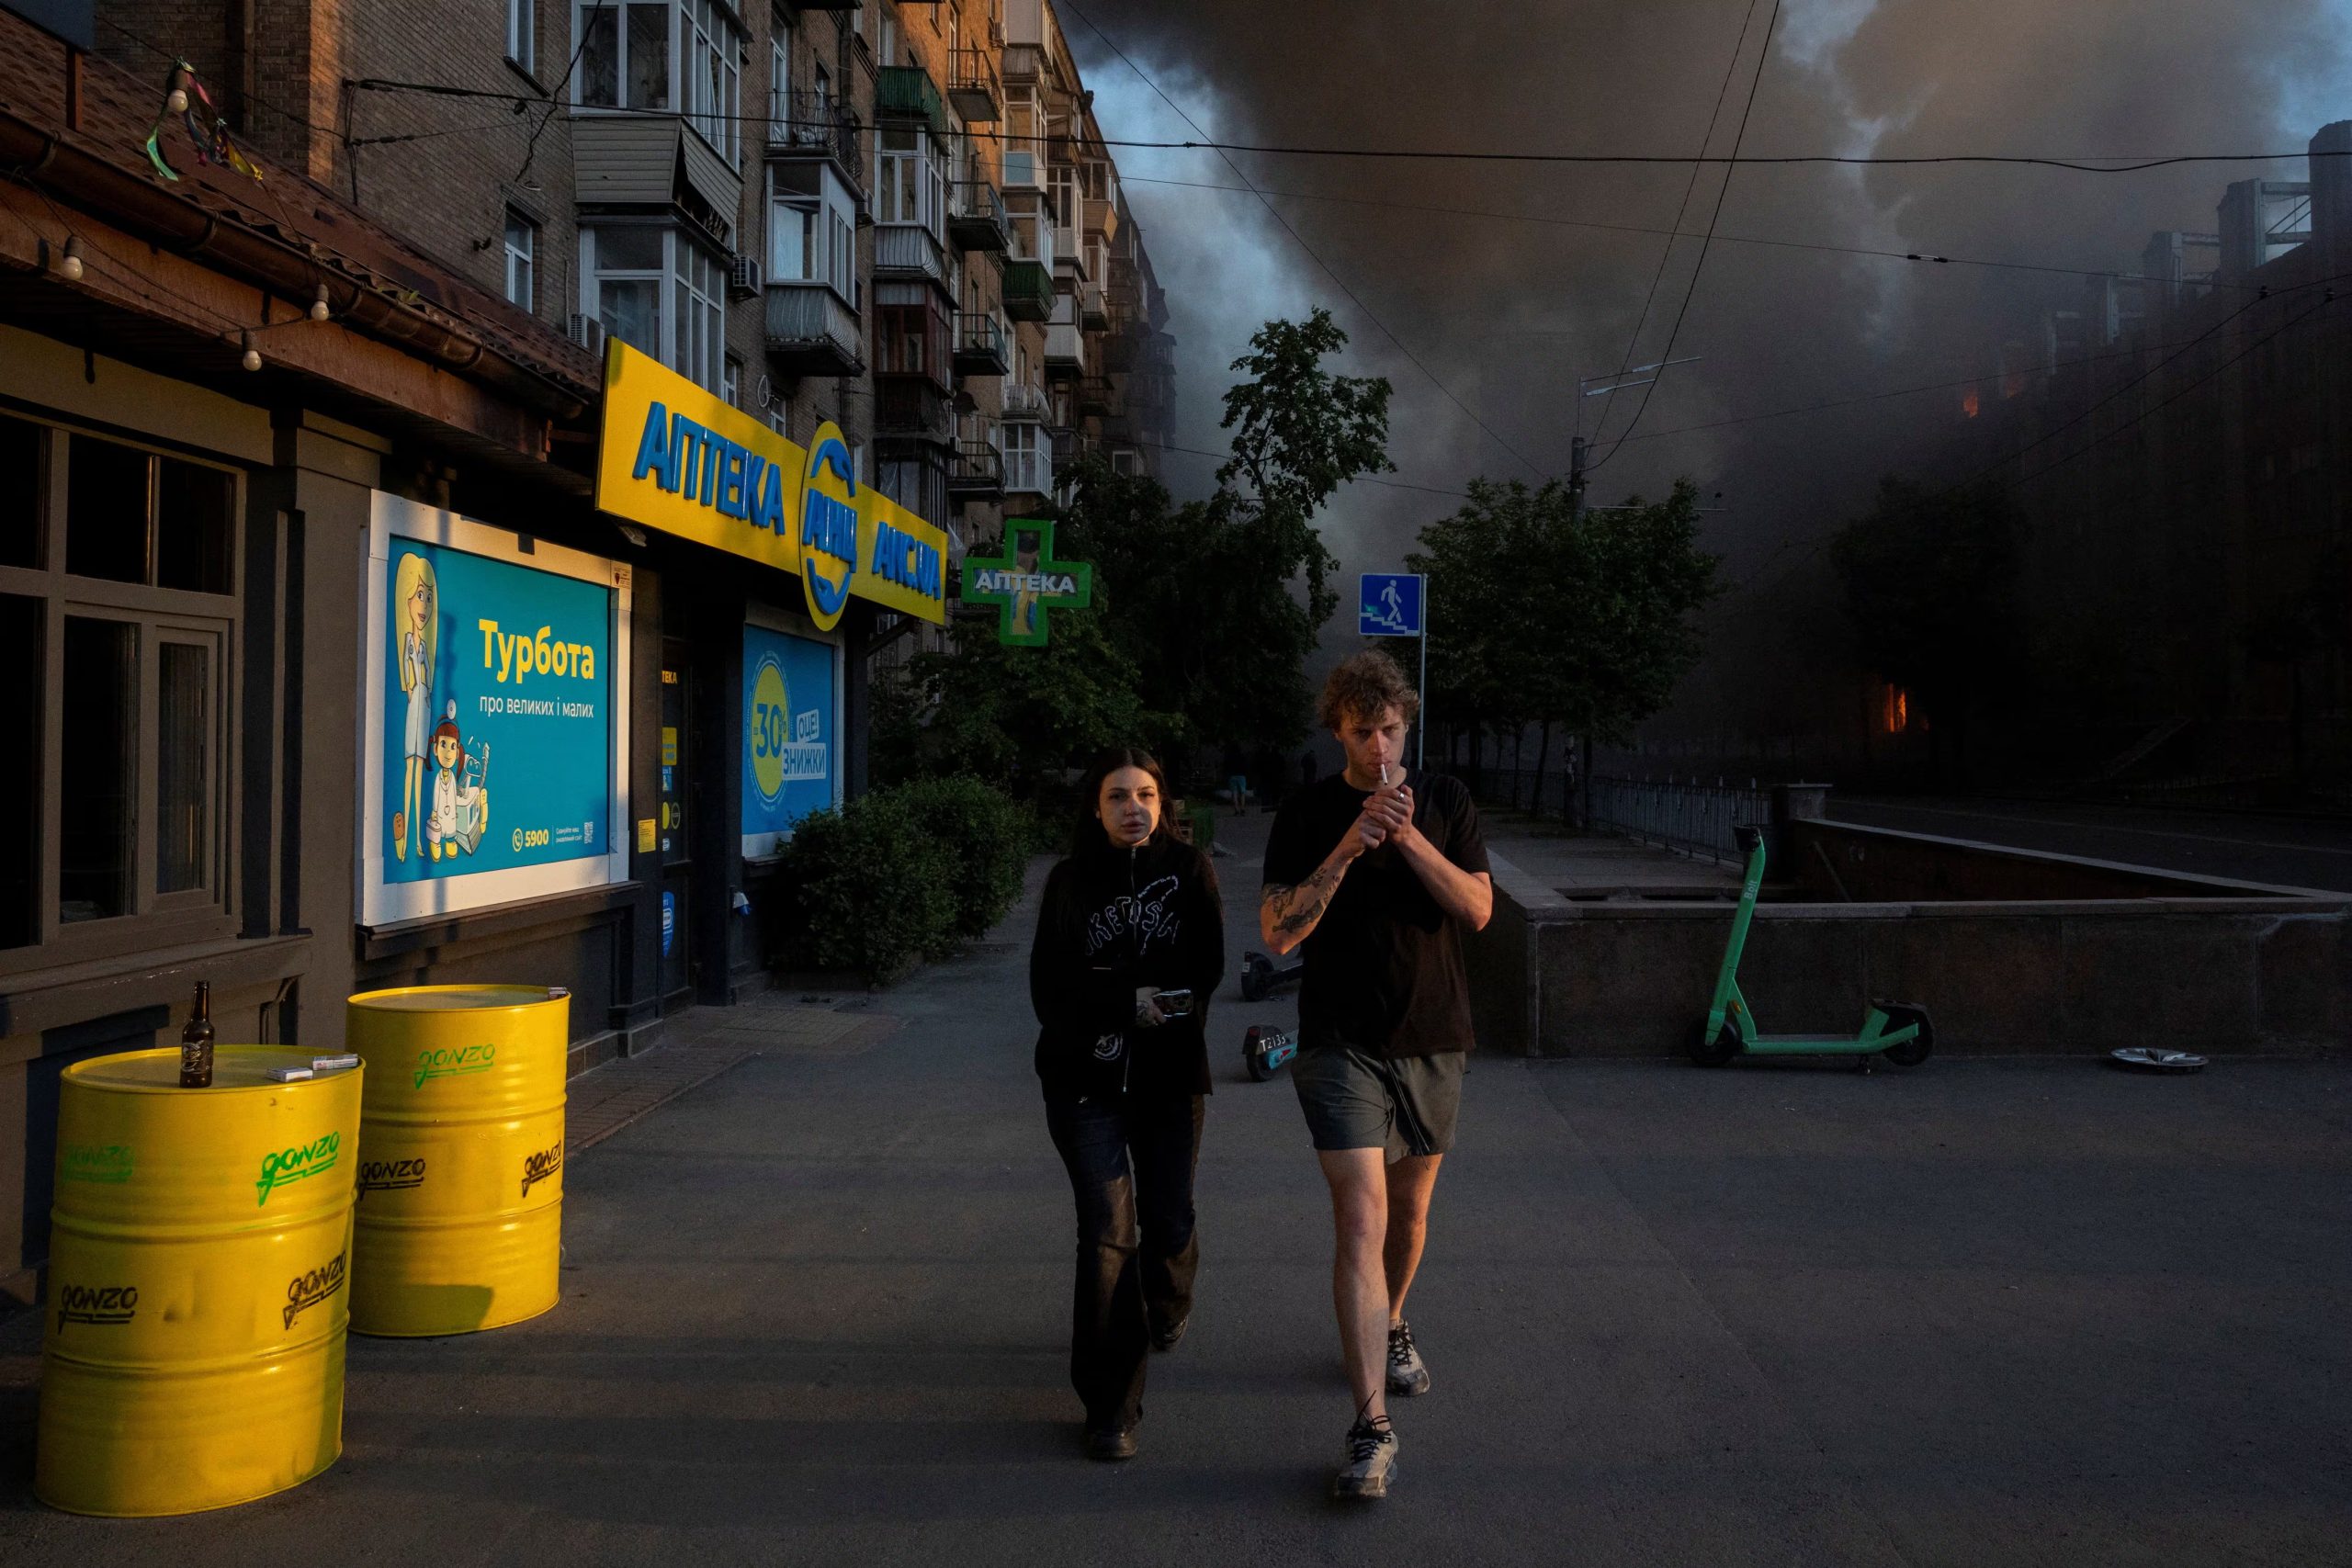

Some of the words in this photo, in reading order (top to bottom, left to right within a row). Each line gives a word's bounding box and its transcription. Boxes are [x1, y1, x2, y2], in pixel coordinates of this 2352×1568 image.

[632, 400, 786, 536] АПТЕКА
[802, 489, 858, 574] АНЦ
[975, 572, 1076, 593] АПТЕКА
[479, 618, 594, 684] Турбота
[480, 695, 503, 716] про
[507, 697, 554, 716] великих
[557, 696, 560, 716] і
[562, 701, 594, 718] малих
[783, 748, 825, 774] ЗНИЖКИ
[525, 829, 549, 848] 5900
[1744, 879, 1758, 901] Bolt
[1260, 1034, 1286, 1052] T2133
